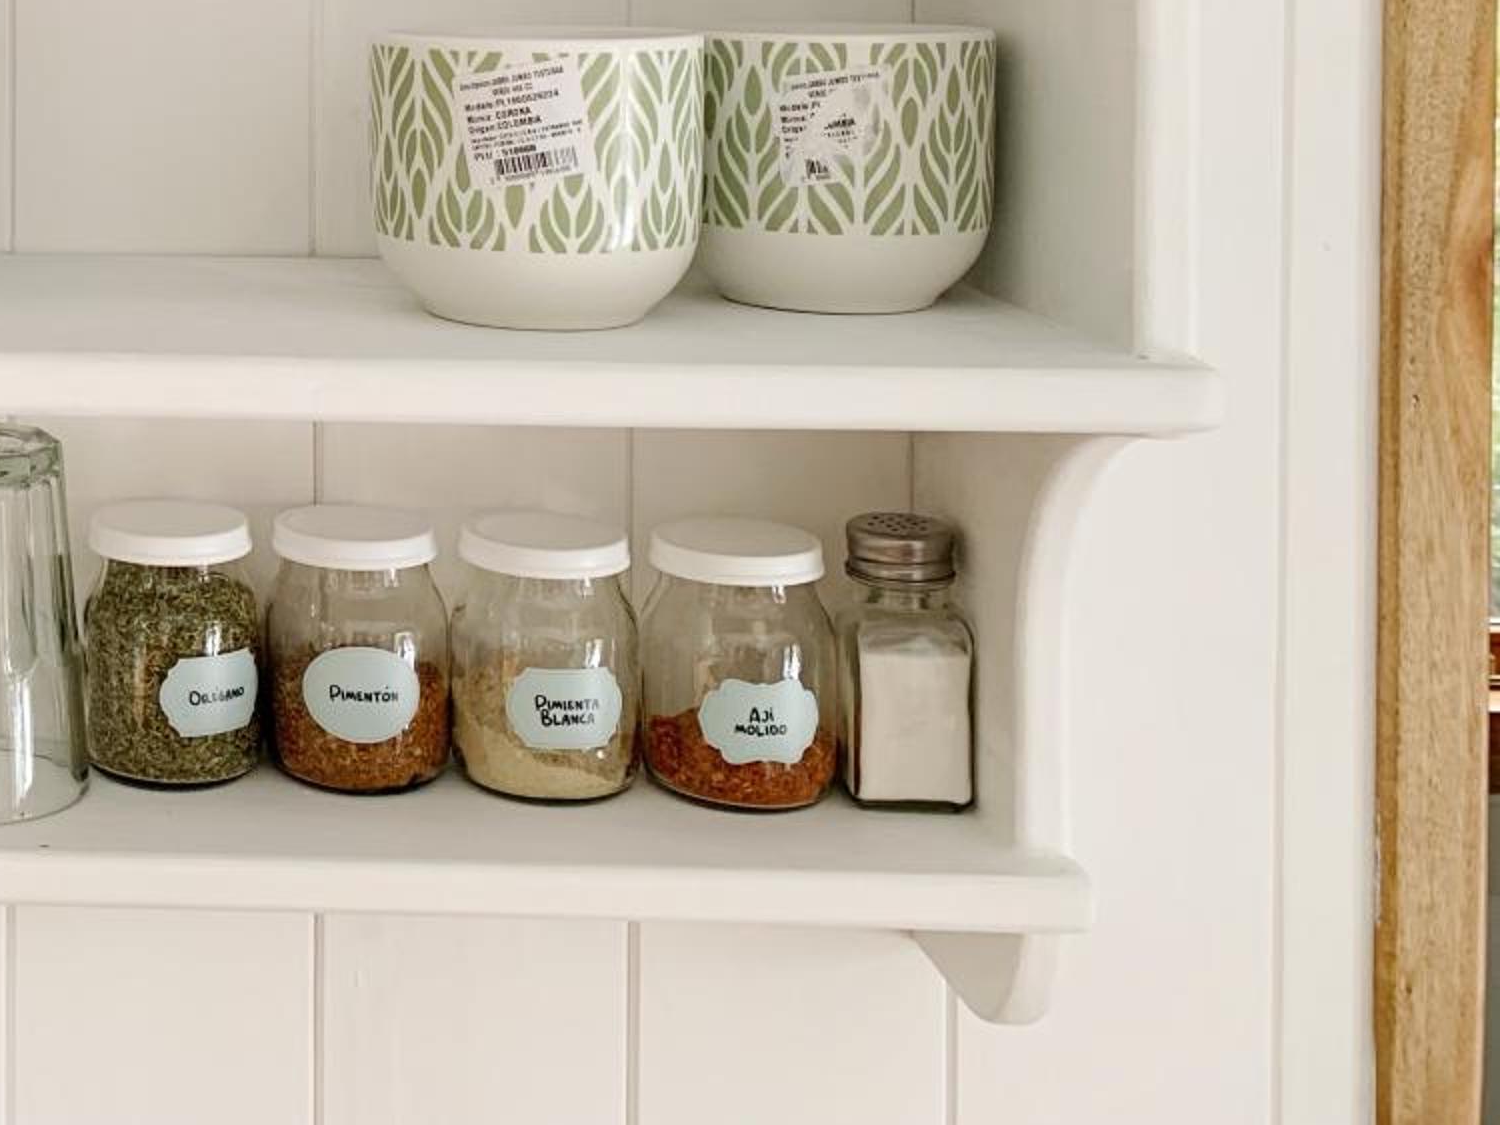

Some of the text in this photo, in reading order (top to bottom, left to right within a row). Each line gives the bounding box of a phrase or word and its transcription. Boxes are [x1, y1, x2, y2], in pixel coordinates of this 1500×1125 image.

[534, 694, 599, 711] PIMIENTA
[541, 708, 595, 727] BLANCA
[734, 723, 788, 737] MOLIDO
